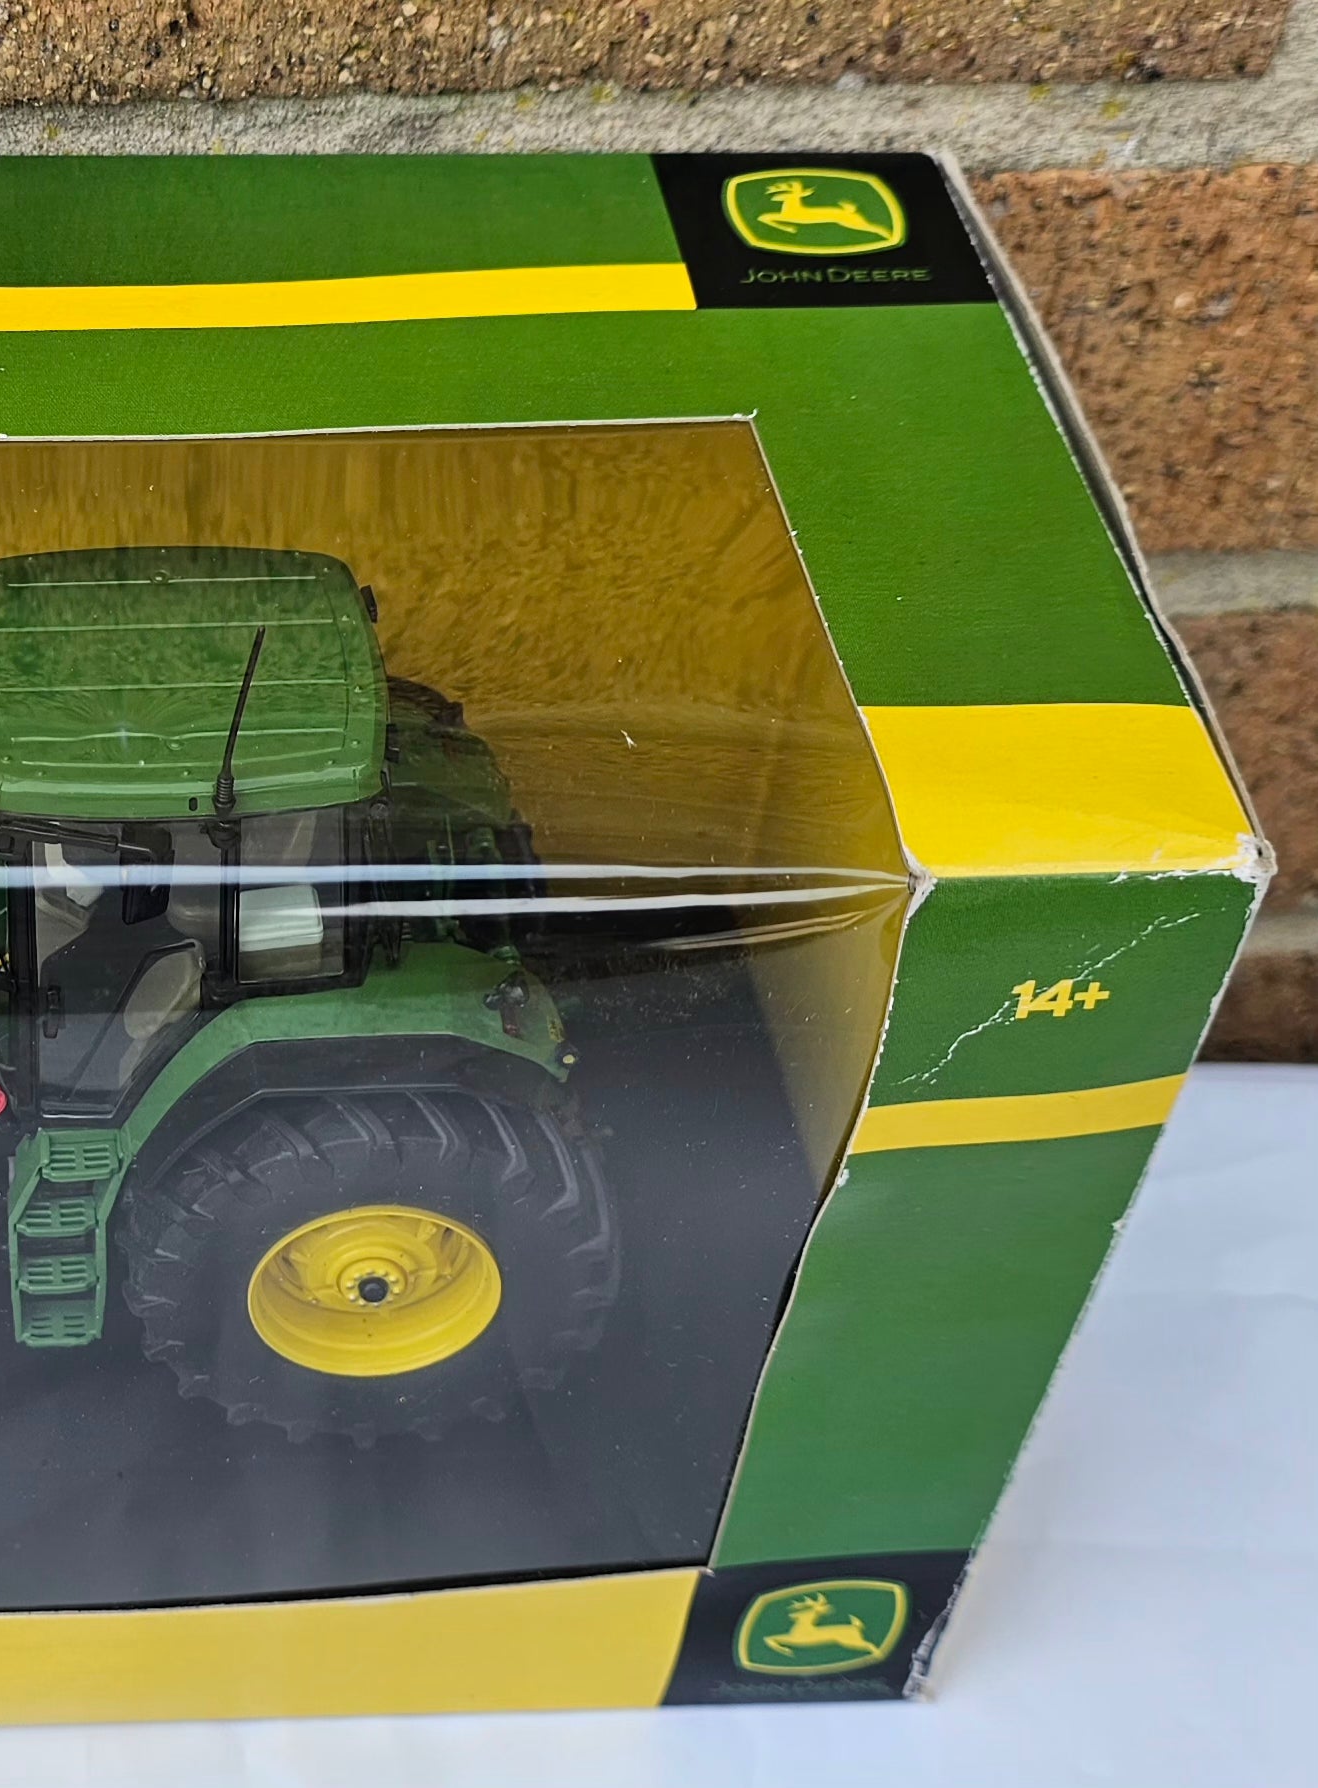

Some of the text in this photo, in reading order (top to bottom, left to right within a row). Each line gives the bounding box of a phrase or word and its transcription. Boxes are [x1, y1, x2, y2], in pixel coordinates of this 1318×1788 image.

[739, 267, 931, 284] JOHN DEERE
[1010, 978, 1111, 1019] 14+
